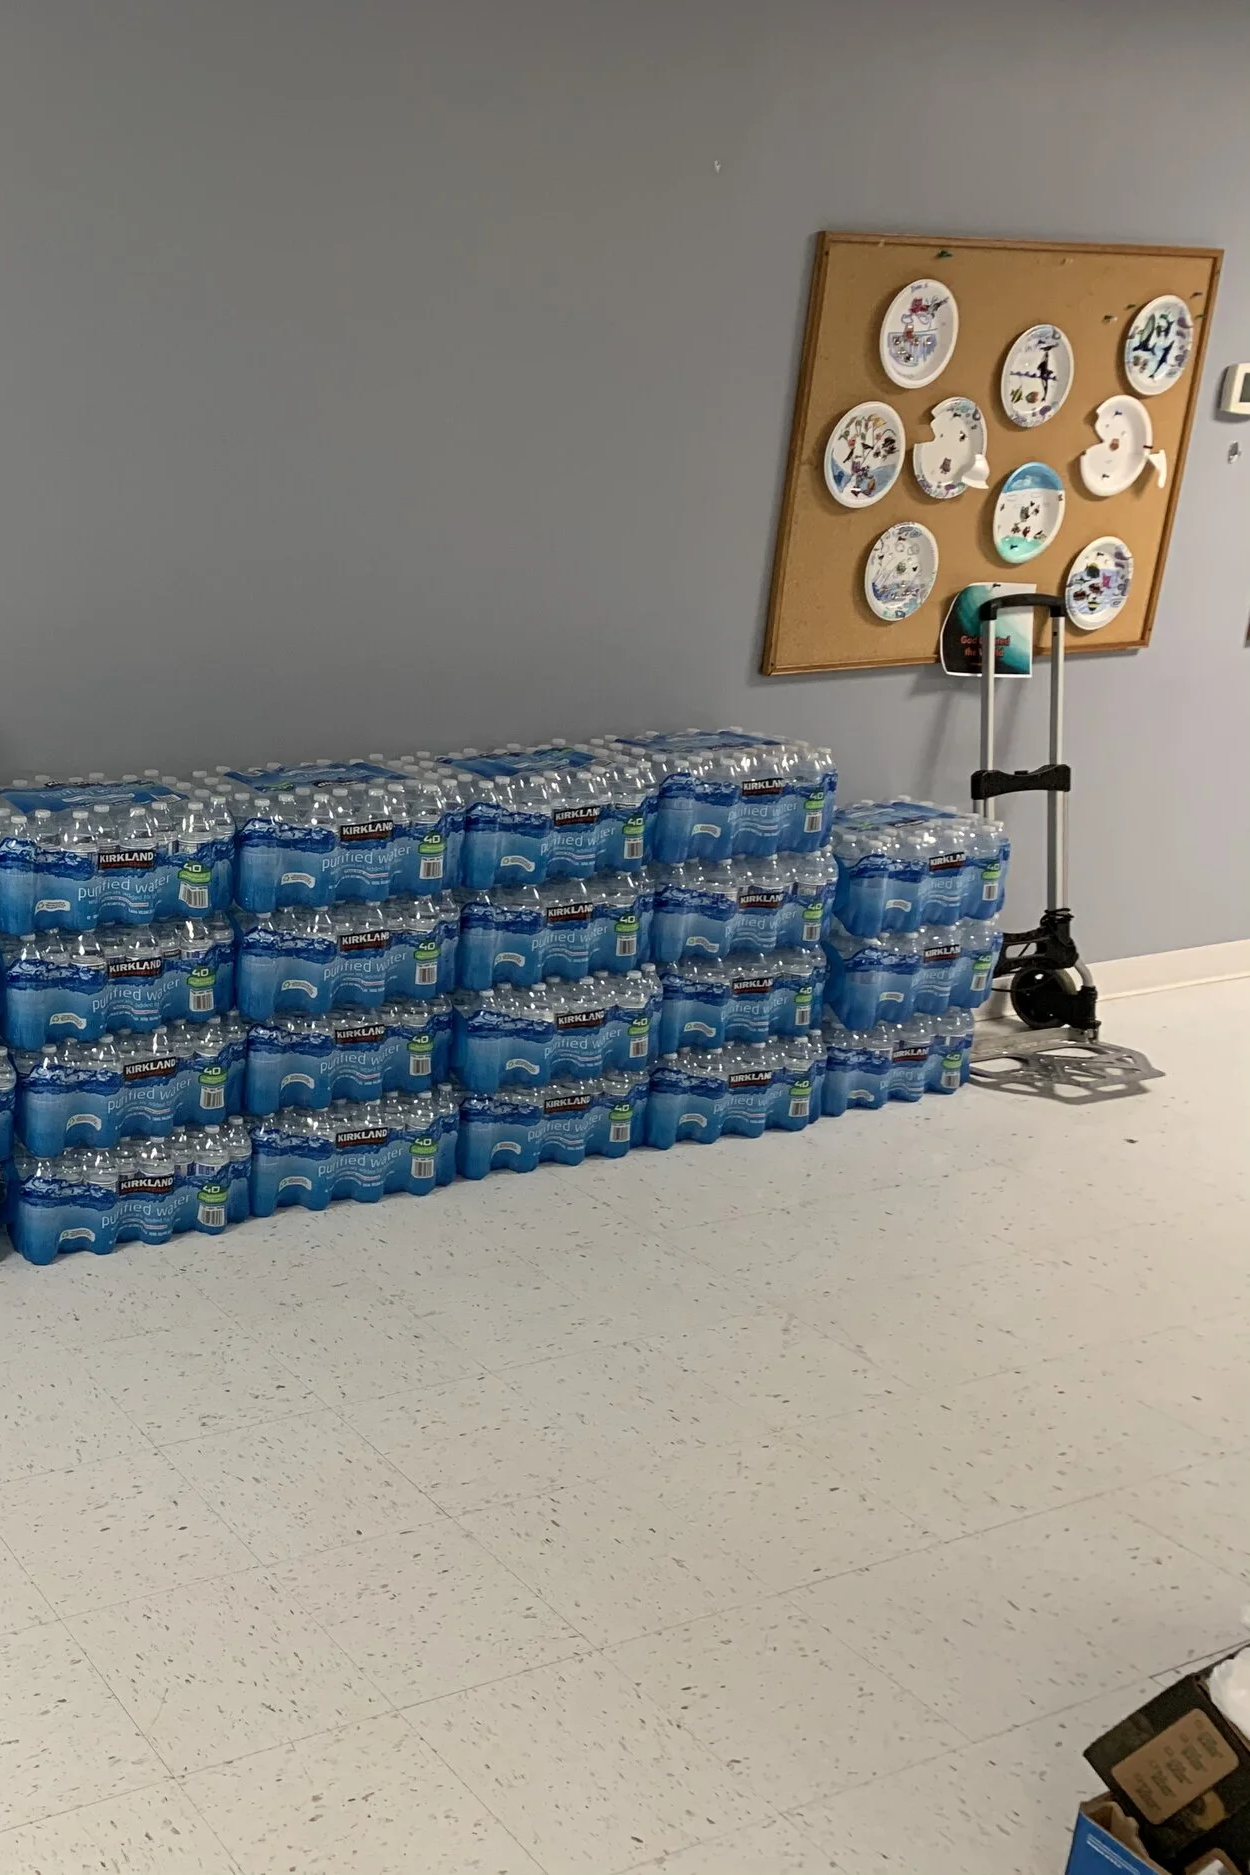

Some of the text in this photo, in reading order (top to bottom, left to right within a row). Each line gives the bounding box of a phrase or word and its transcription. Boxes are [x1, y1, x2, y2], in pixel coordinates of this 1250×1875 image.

[744, 778, 784, 790] KIRKLAN
[556, 807, 600, 820] KIRKLAN
[343, 821, 392, 835] KIRKLAND
[424, 835, 440, 843] 40
[100, 852, 153, 863] KIRKLAND
[322, 845, 412, 872] purified water
[931, 853, 967, 865] KIRKLAN
[184, 864, 201, 872] 40
[78, 875, 170, 901] purified water
[740, 894, 782, 903] KIRKLAN
[420, 942, 435, 950] 40
[926, 946, 960, 957] KIRKLAN
[110, 959, 161, 973] KIRKLAND
[192, 968, 208, 976] 40
[734, 979, 773, 989] KIRKLAN
[93, 978, 179, 1013] purified water
[412, 1035, 428, 1043] 40
[893, 1048, 929, 1058] KIRKLAN
[126, 1058, 176, 1074] KIRKLAND
[204, 1067, 221, 1075] 40
[731, 1072, 772, 1082] KIRKLAN
[108, 1077, 191, 1113] purified water
[338, 1129, 388, 1142] KIRKLAND
[415, 1138, 431, 1146] 40
[121, 1178, 173, 1188] KIRKLAND
[203, 1186, 220, 1194] 40
[102, 1194, 190, 1228] purified water
